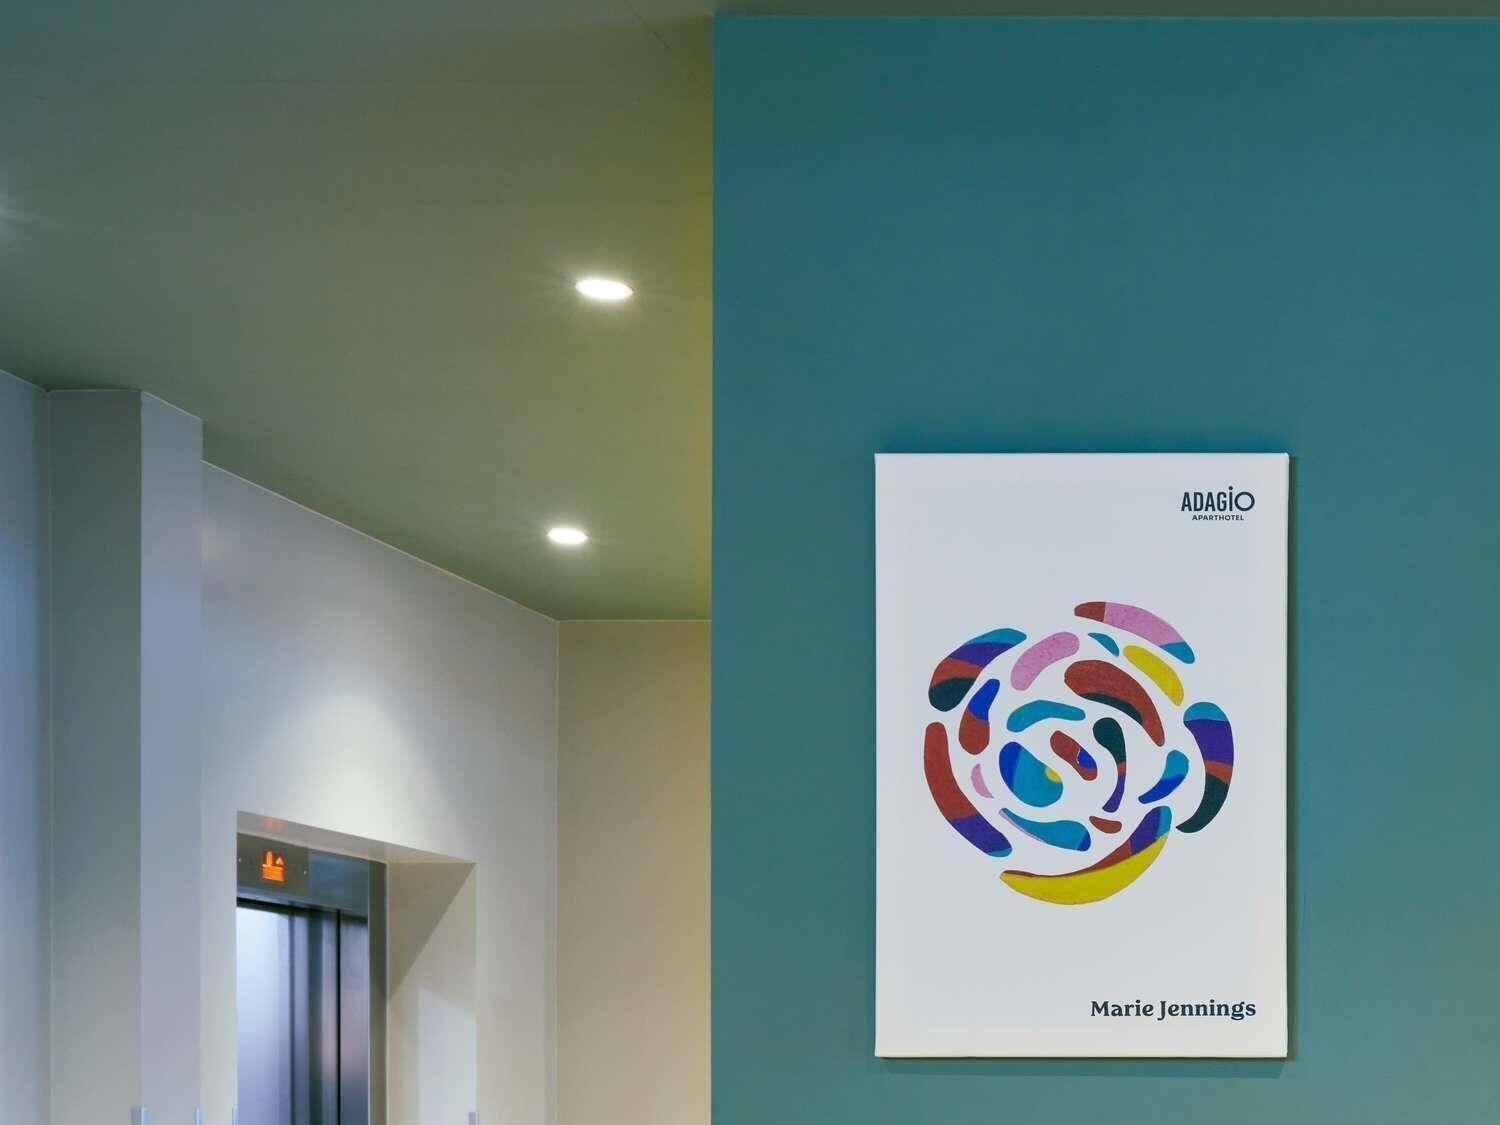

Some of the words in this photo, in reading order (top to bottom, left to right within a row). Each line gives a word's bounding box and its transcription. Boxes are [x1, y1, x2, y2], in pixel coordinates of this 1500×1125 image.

[1191, 514, 1245, 522] APARTHOTEL
[1090, 999, 1154, 1017] Marie
[1156, 998, 1257, 1022] Jennings
